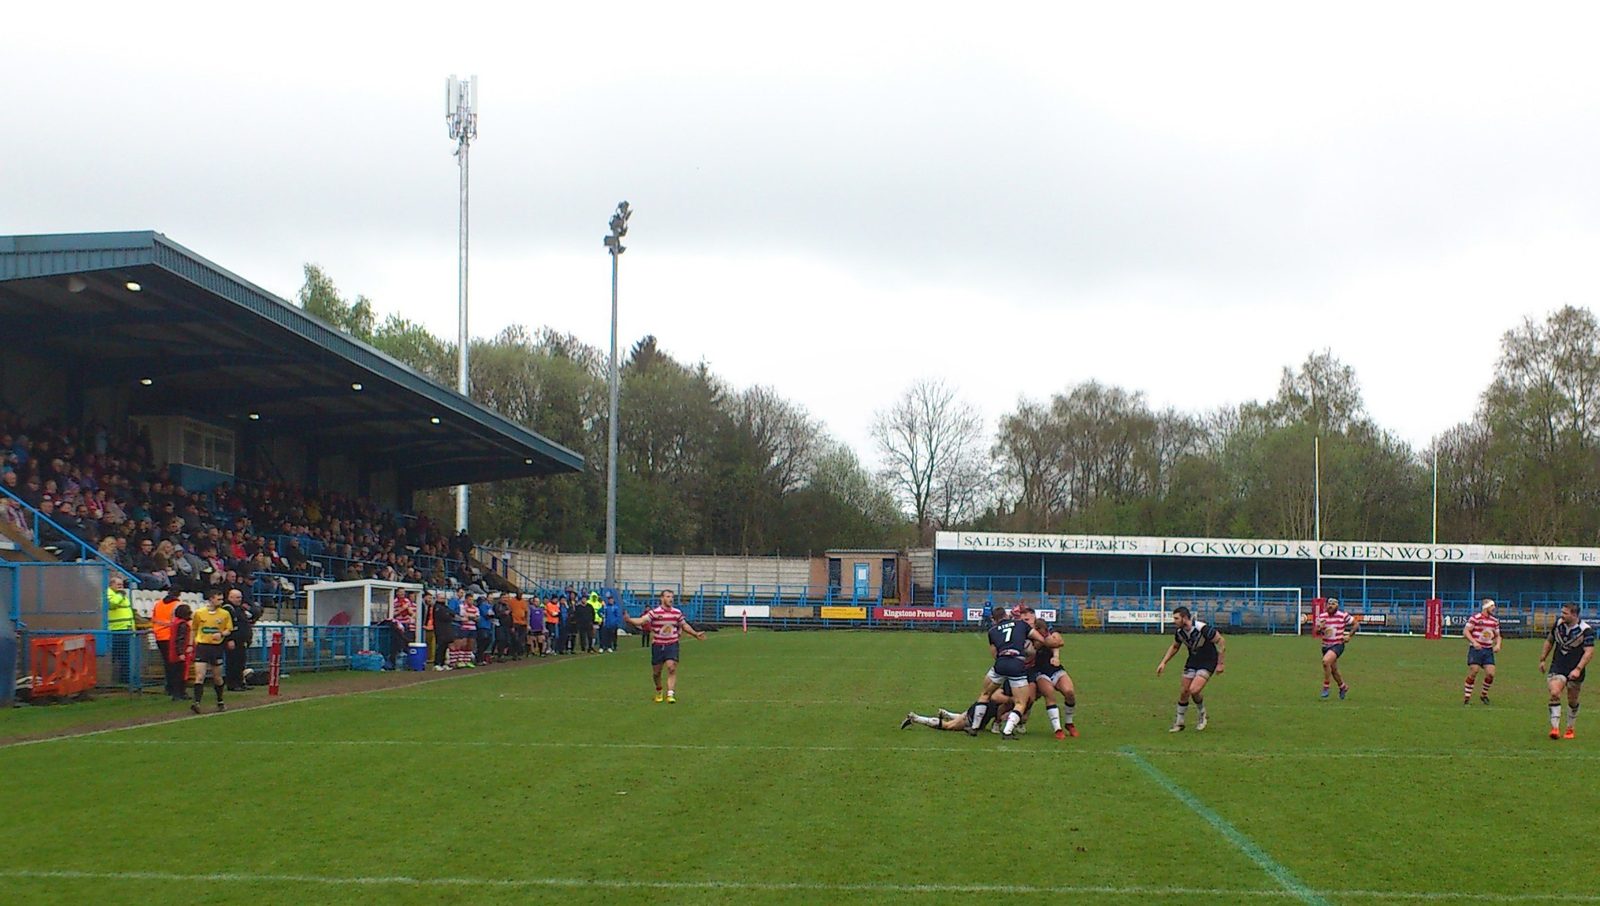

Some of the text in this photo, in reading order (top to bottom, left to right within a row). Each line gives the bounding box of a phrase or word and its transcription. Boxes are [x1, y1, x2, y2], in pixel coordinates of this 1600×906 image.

[964, 535, 1138, 551] SALES SERVICE PARTS
[1162, 539, 1465, 560] LOCKWOOD & GREENWOOD
[1487, 550, 1540, 561] Audenshaw
[883, 609, 954, 618] Kingstone Press Cider
[1002, 627, 1013, 643] 7
